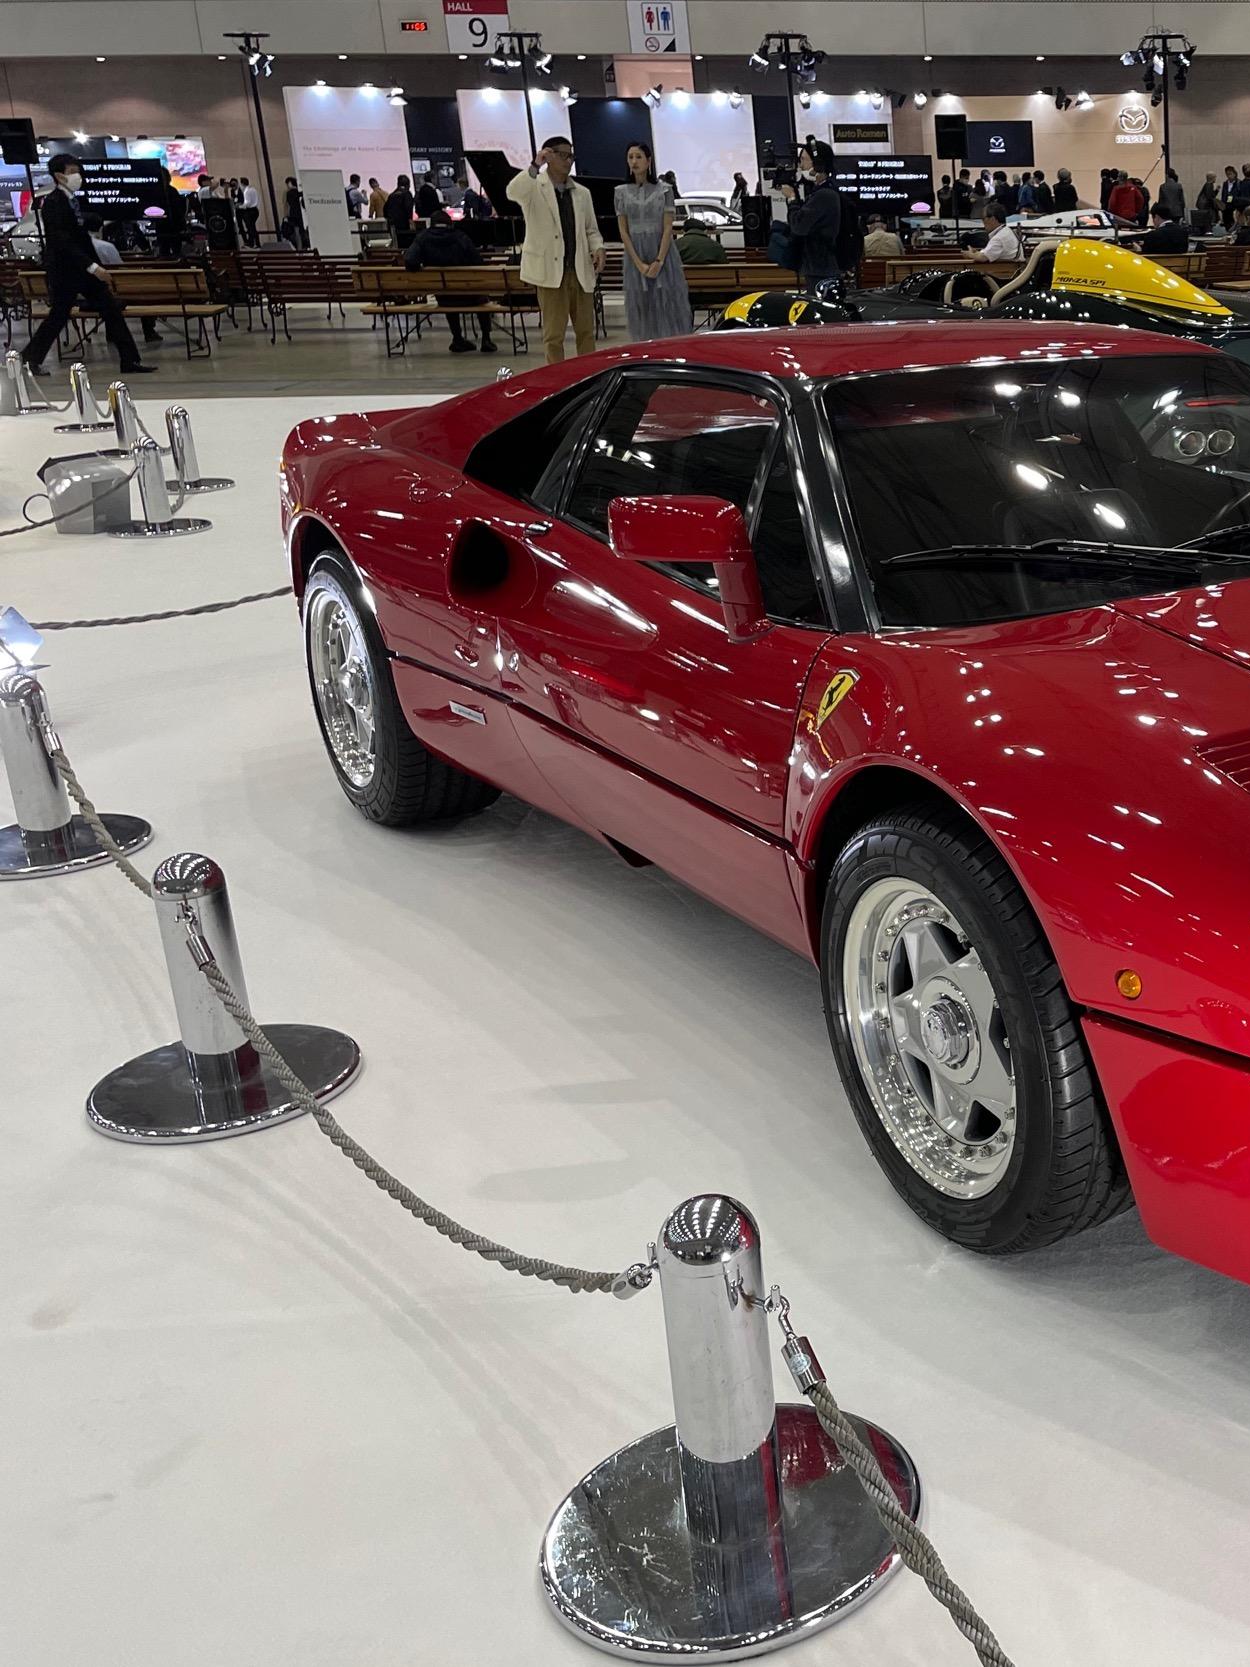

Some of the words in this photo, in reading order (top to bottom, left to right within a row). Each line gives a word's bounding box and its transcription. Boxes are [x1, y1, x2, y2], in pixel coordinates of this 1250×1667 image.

[447, 3, 473, 12] HALL
[468, 17, 488, 48] 9
[1056, 276, 1088, 284] MONZA
